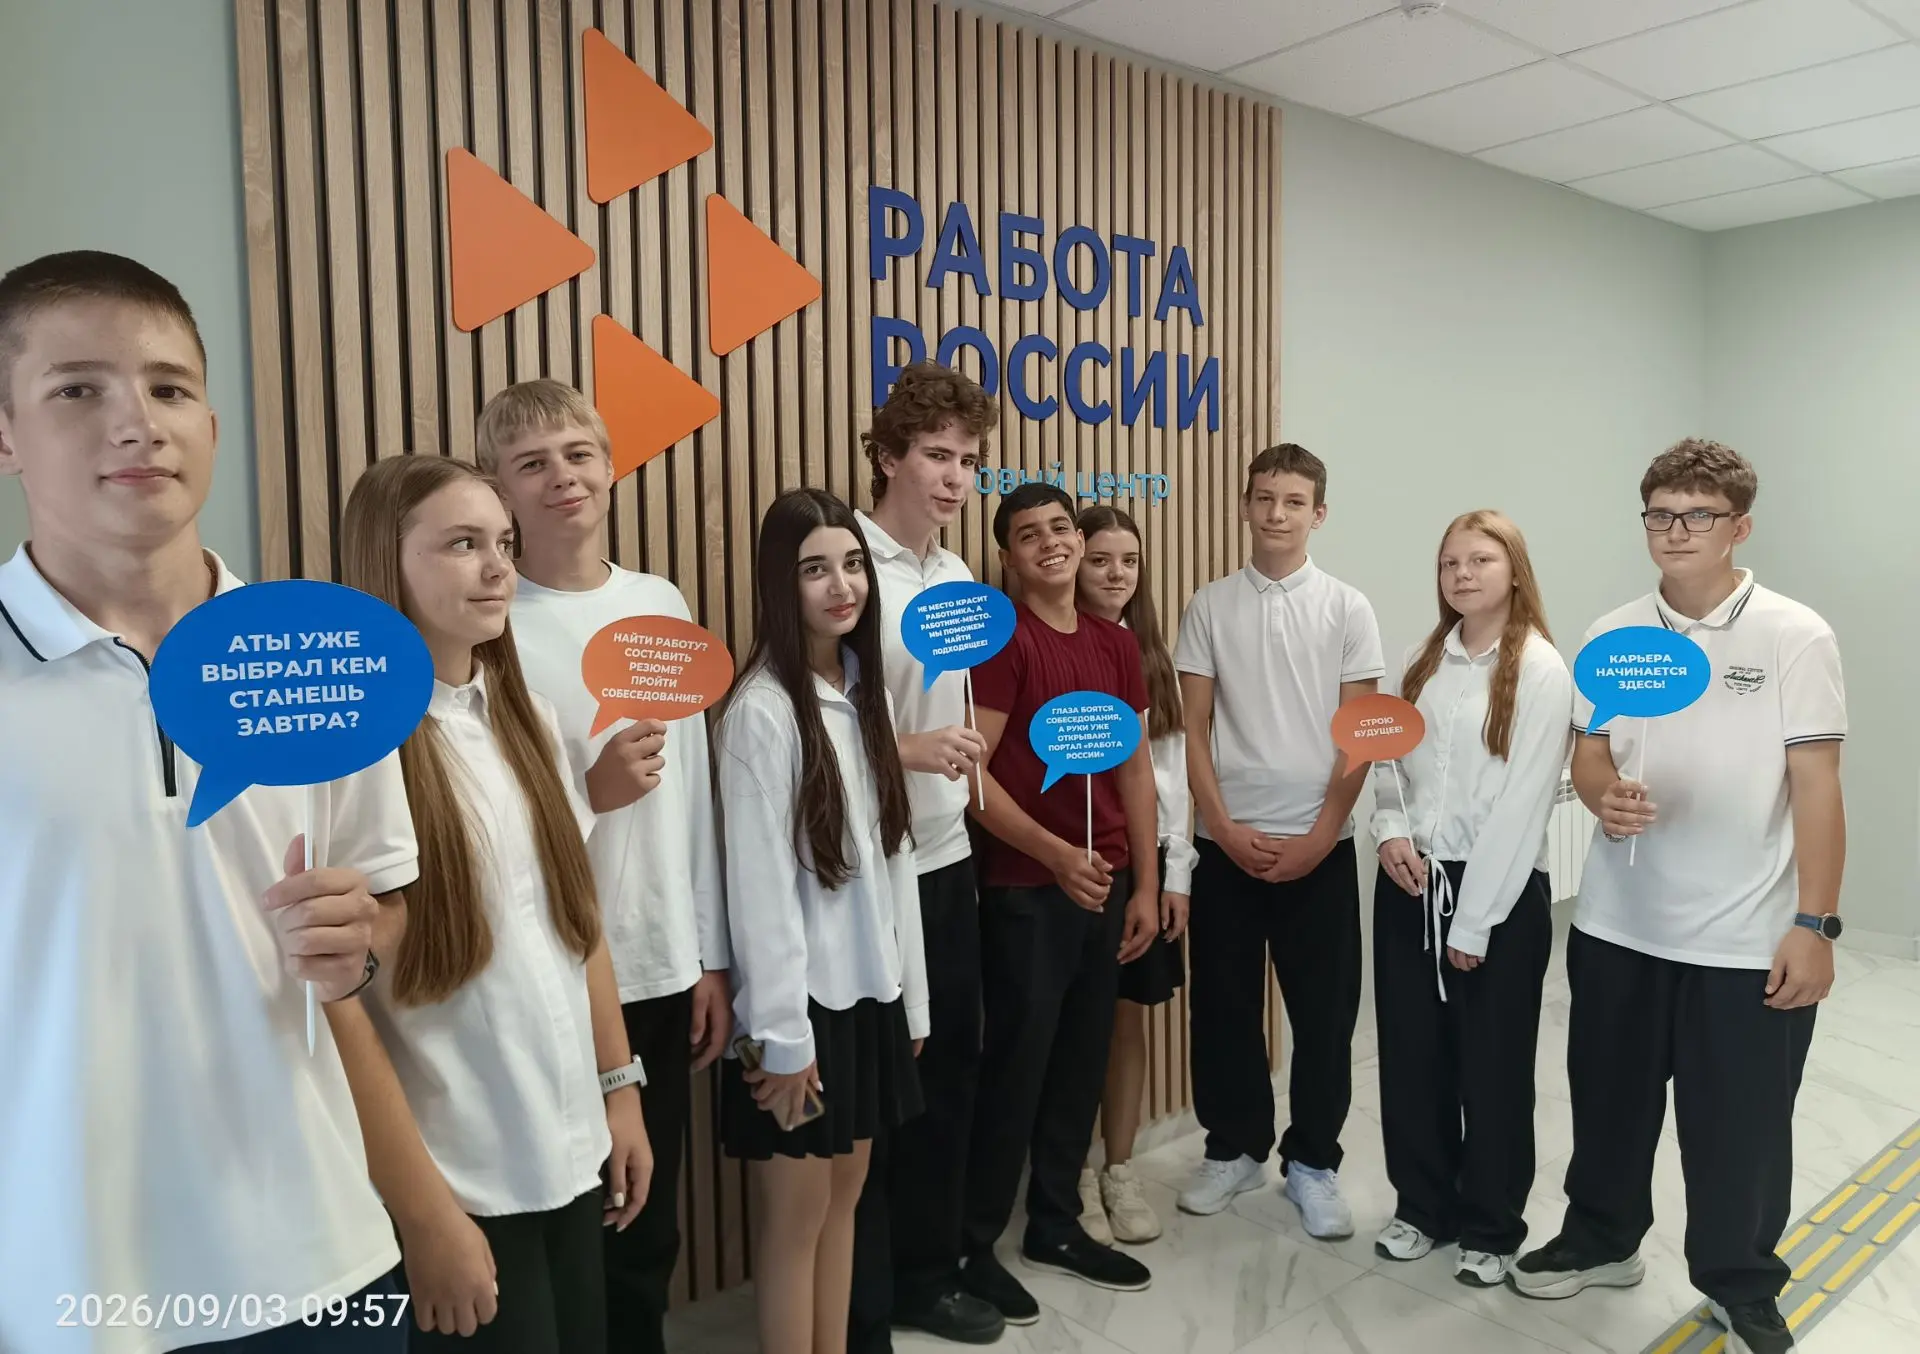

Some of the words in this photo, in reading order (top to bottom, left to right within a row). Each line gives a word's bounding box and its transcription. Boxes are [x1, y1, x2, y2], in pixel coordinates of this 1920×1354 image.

[869, 185, 1204, 327] РАБОТА
[871, 316, 1219, 432] РОССИИ
[1077, 472, 1170, 506] центр
[929, 601, 954, 611] МЕСТО
[956, 596, 988, 606] КРАСИТ
[926, 608, 974, 620] РАБОТНИКА,
[944, 623, 984, 635] ПОМОЖЕМ
[299, 631, 360, 650] УЖЕ
[613, 632, 652, 645] НАЙТИ
[656, 637, 708, 651] РАБОТУ?
[944, 634, 971, 644] НАЙТИ
[933, 640, 988, 655] ПОДХОДЯЩЕЕ!
[625, 648, 692, 663] СОСТАВИТЬ
[1609, 654, 1672, 663] КАРЬЕРА
[202, 659, 322, 682] ВЫБРАЛ
[332, 656, 387, 675] КЕМ
[629, 662, 683, 675] РЕЗЮМЕ?
[1596, 667, 1687, 677] НАЧИНАЕТСЯ
[631, 675, 677, 688] ПРОЙТИ
[1618, 680, 1665, 690] ЗДЕСЬ!
[229, 684, 365, 709] СТАНЕШЬ
[602, 688, 703, 704] СОБЕСЕДОВАНИЕ?
[1081, 705, 1113, 713] БОЯТСЯ
[237, 711, 360, 737] ЗАВТРА?
[1046, 714, 1122, 724] СОБЕСЕДОВАНИЯ,
[1360, 717, 1393, 727] СТРОЮ
[1057, 732, 1111, 742] ОТКРЫВАЮТ
[1354, 726, 1403, 738] БУДУЩЕЕ!
[1048, 743, 1081, 751] ПОРТАЛ
[1084, 741, 1123, 749] «РАБОТА
[1066, 751, 1104, 759] РОССИИ»
